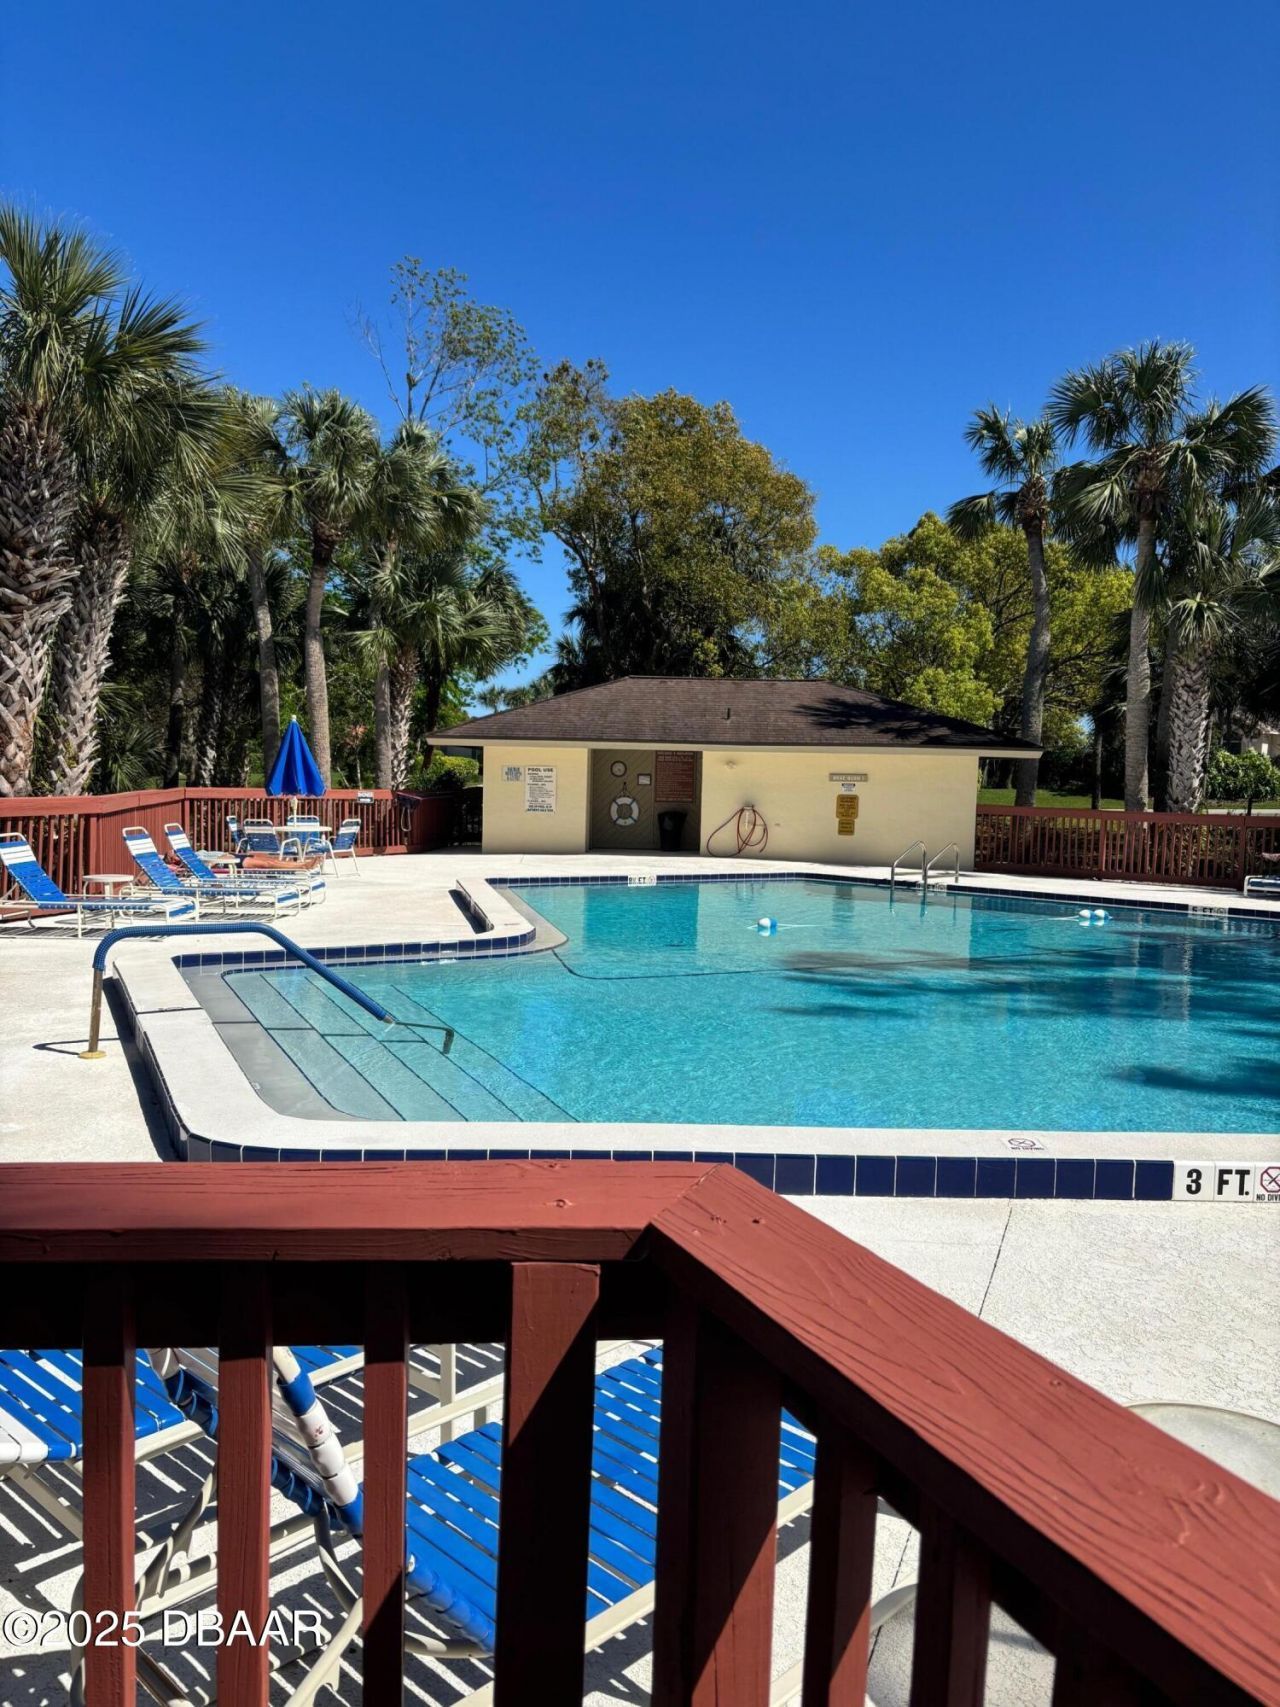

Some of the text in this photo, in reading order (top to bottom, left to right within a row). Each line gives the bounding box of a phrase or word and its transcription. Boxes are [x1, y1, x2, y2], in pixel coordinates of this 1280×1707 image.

[1185, 1168, 1251, 1196] 3 FT.
[1256, 1193, 1266, 1201] NO
